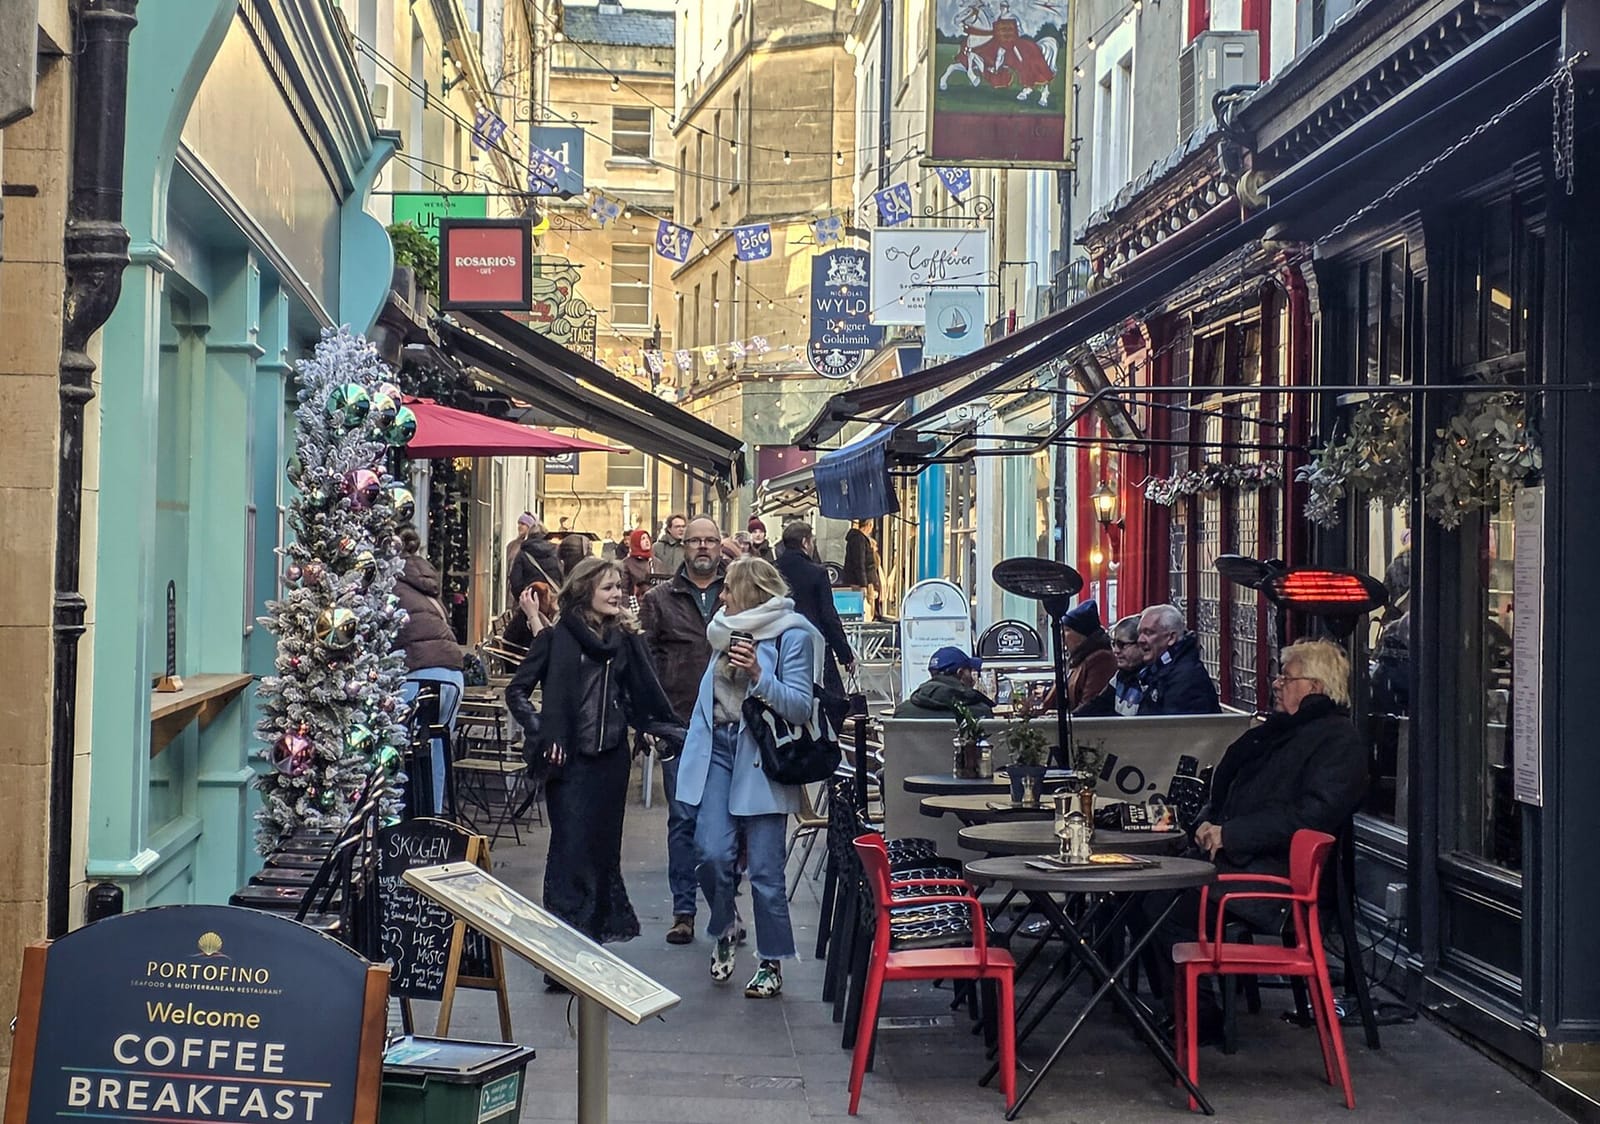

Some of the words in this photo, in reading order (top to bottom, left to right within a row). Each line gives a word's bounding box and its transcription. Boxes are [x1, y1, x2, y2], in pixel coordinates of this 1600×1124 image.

[741, 233, 769, 251] 250
[455, 256, 516, 267] ROSARIO'S
[816, 299, 867, 313] WYLD
[826, 319, 866, 332] Digner
[822, 334, 870, 344] Goldsmith
[147, 961, 269, 985] PORTOFINO
[174, 983, 235, 993] MEDITERRANEAN
[237, 987, 283, 995] RESTAURANT
[146, 1001, 261, 1029] Welcome
[113, 1033, 286, 1074] COFFEE
[67, 1076, 324, 1122] BREAKFAST
